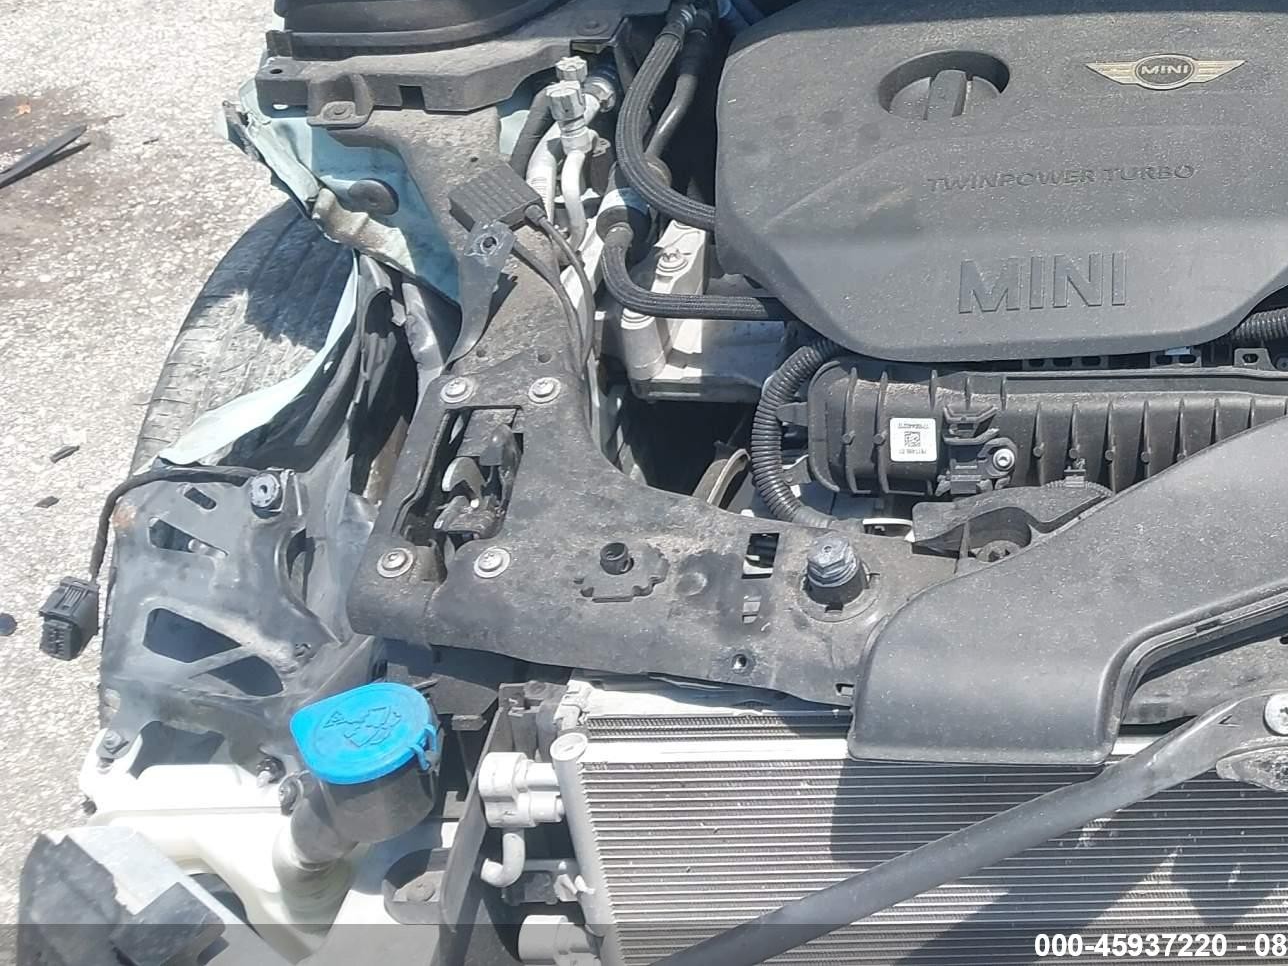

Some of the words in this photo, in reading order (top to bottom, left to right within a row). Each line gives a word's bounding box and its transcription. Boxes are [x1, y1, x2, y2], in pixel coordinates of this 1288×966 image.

[1140, 65, 1190, 75] MINI
[926, 168, 1098, 192] TWINPOWER
[1103, 164, 1196, 182] TURBO
[958, 251, 1127, 314] MINI
